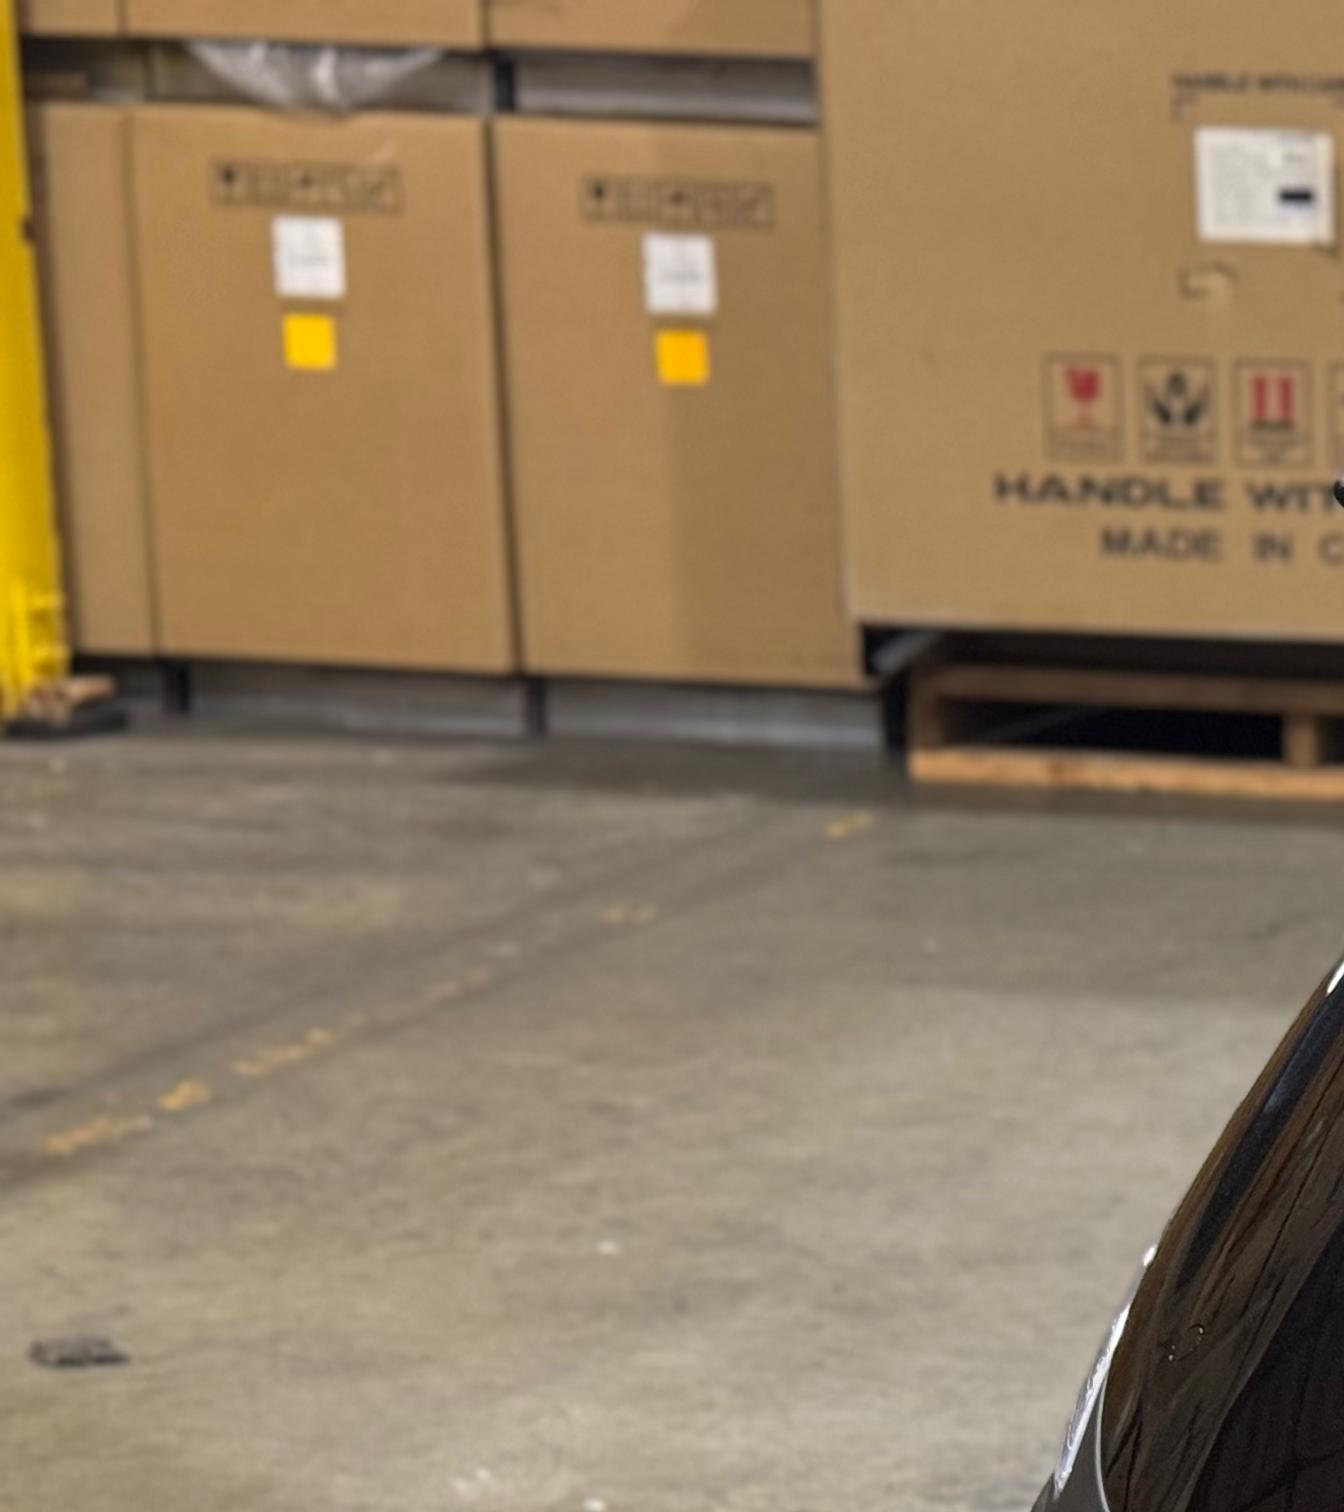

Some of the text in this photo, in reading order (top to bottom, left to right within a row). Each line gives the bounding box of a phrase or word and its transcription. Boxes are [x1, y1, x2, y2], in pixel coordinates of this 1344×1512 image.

[995, 473, 1225, 511] HANDLE
[1100, 527, 1222, 558] MADE
[1254, 531, 1293, 561] IN
